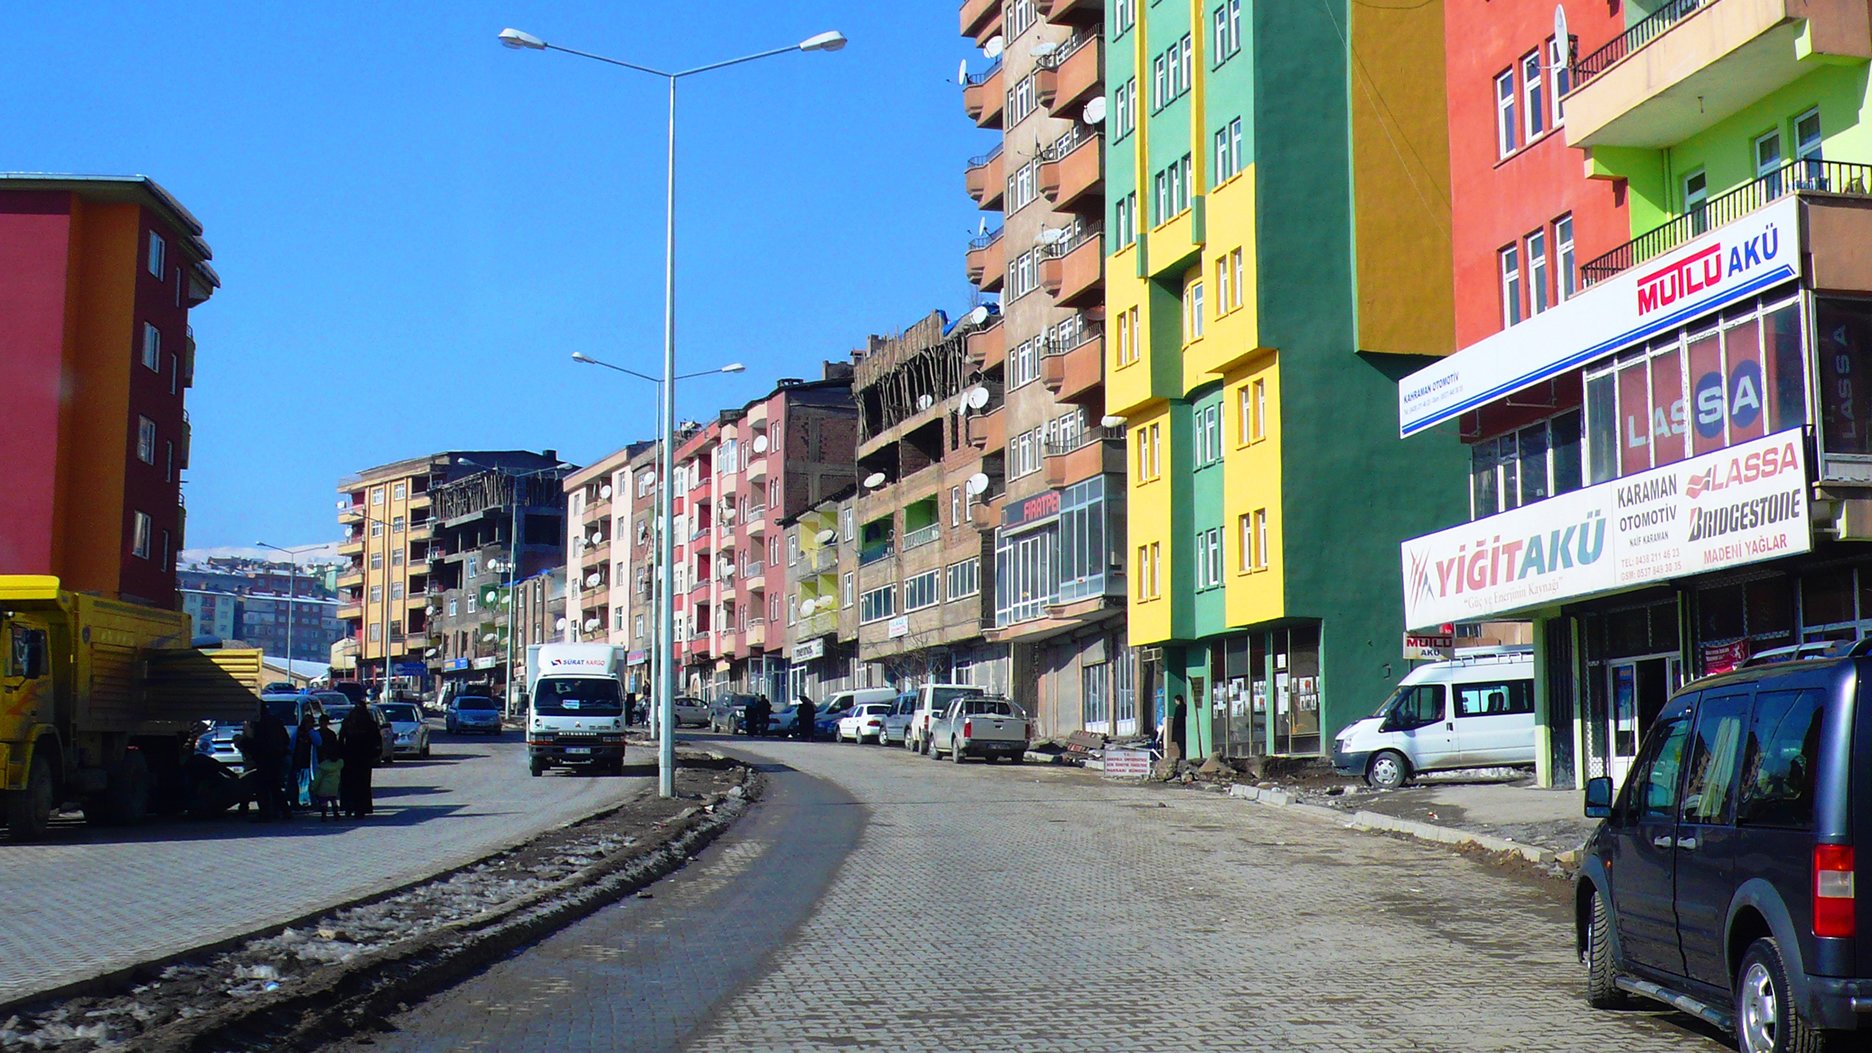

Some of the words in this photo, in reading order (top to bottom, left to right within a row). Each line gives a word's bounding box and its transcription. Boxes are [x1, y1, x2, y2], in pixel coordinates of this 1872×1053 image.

[1637, 242, 1722, 316] MUTLU
[1728, 223, 1777, 277] AKÜ
[1404, 384, 1432, 403] KAHRAMAN
[1833, 324, 1857, 439] LASSA
[1628, 375, 1760, 448] LASSA
[1711, 442, 1798, 492] LASSA
[1617, 473, 1677, 509] KARAMAN
[1619, 503, 1677, 532] OTOMOTİV
[1688, 488, 1801, 542] BRIDGESTONE
[1643, 531, 1669, 545] KARAMAN
[1704, 540, 1743, 564] MADENİ
[1745, 533, 1787, 556] YAĞLAR
[1407, 636, 1453, 648] MUTLU
